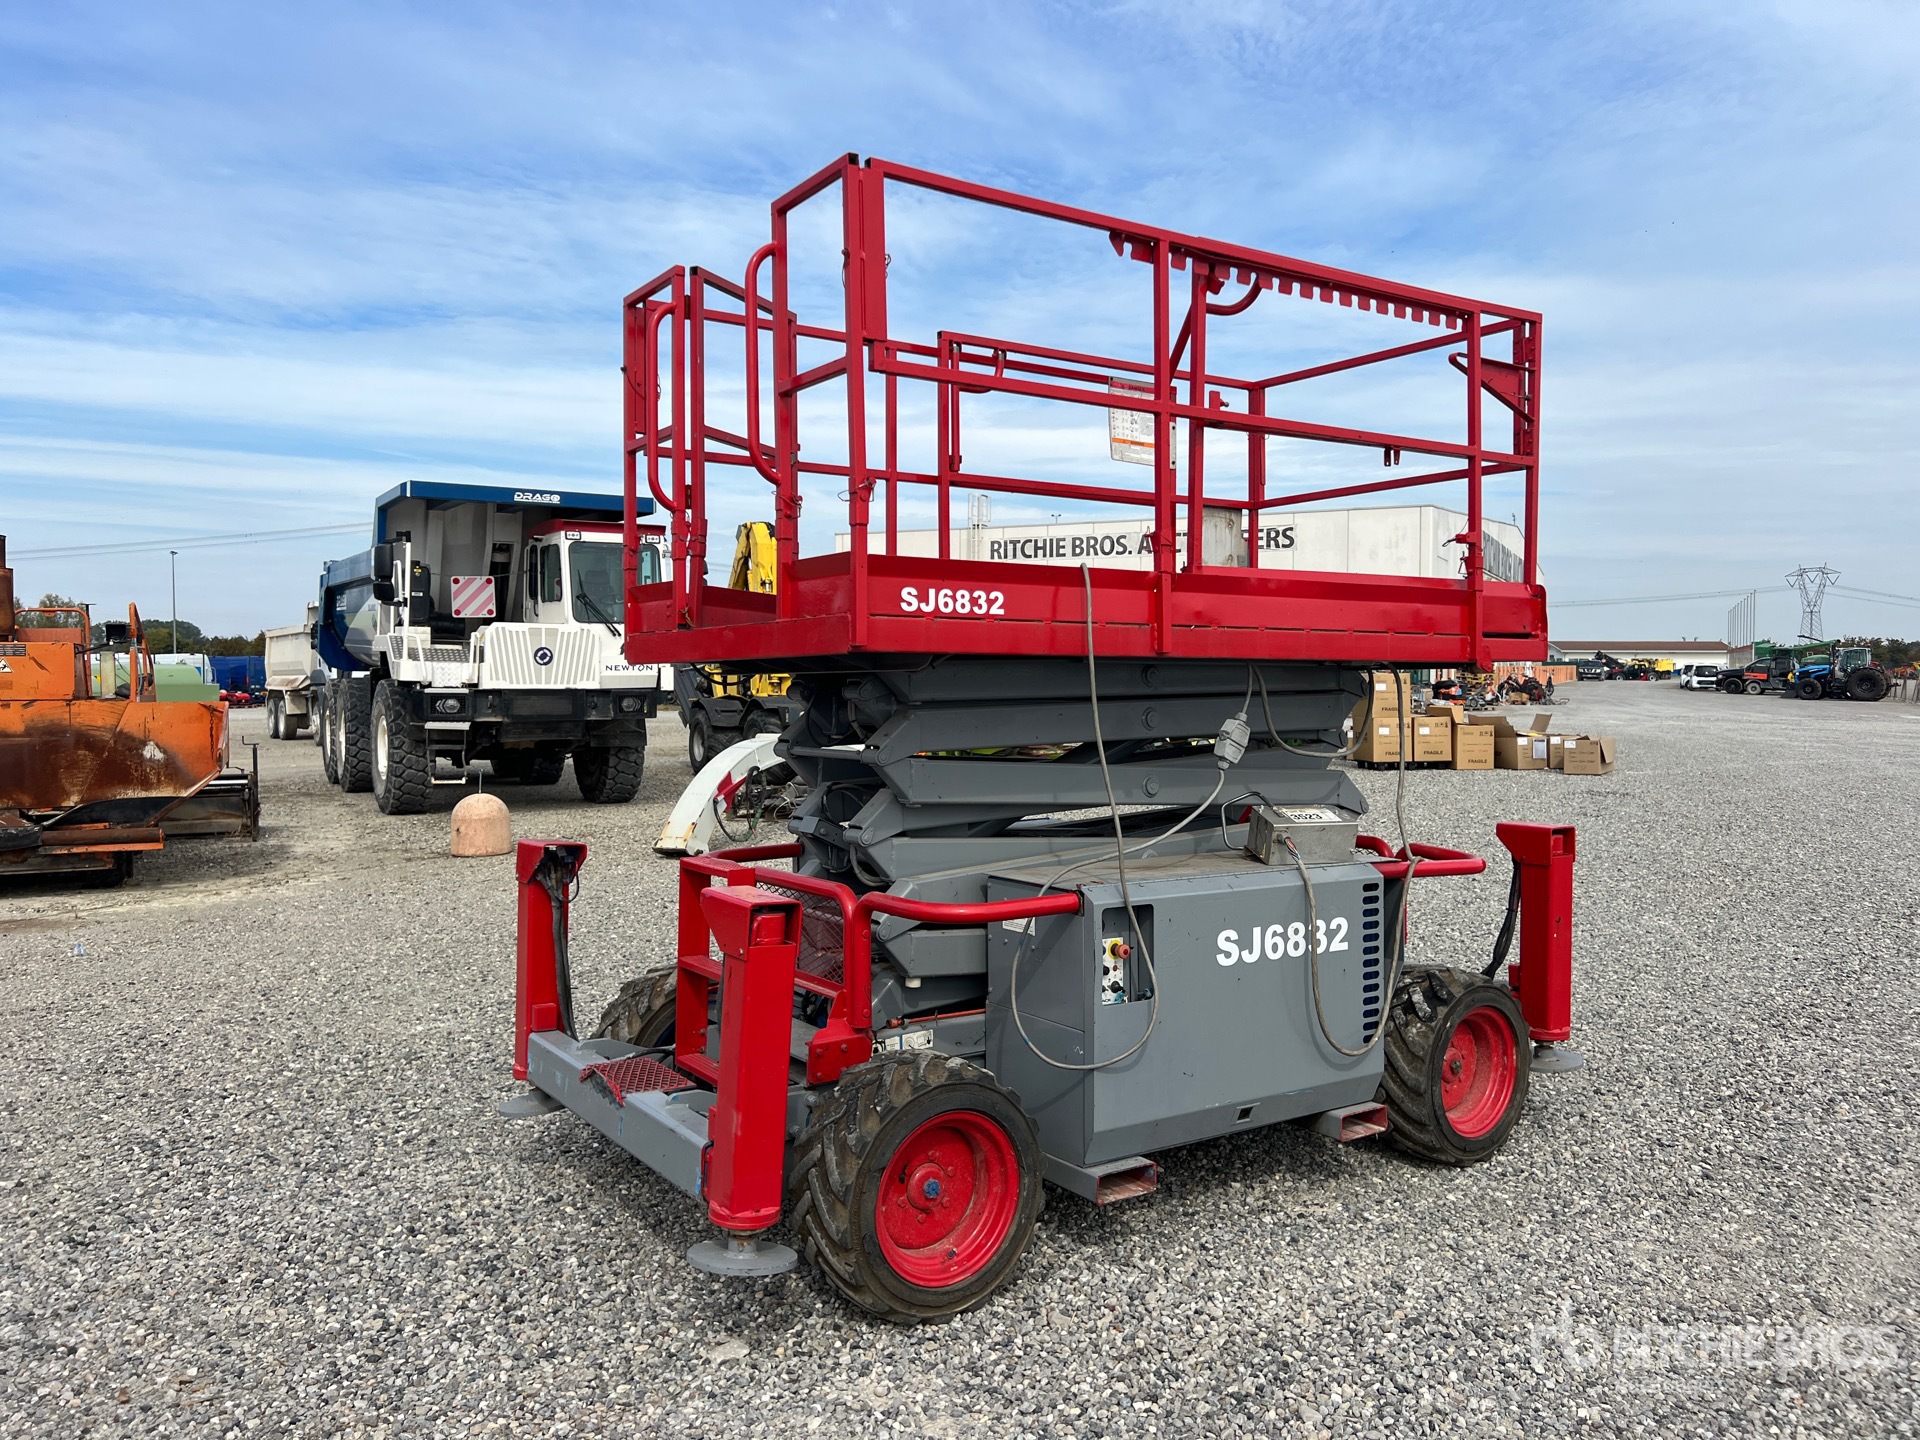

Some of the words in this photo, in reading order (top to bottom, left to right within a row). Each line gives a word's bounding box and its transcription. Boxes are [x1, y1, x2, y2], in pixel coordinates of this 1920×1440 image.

[514, 492, 560, 502] DRAGO
[990, 538, 1066, 560] RITCHIE
[1071, 535, 1132, 557] BROS.
[900, 587, 1004, 615] SJ6832
[605, 664, 653, 672] NEWTON
[1216, 917, 1349, 966] SJ6832
